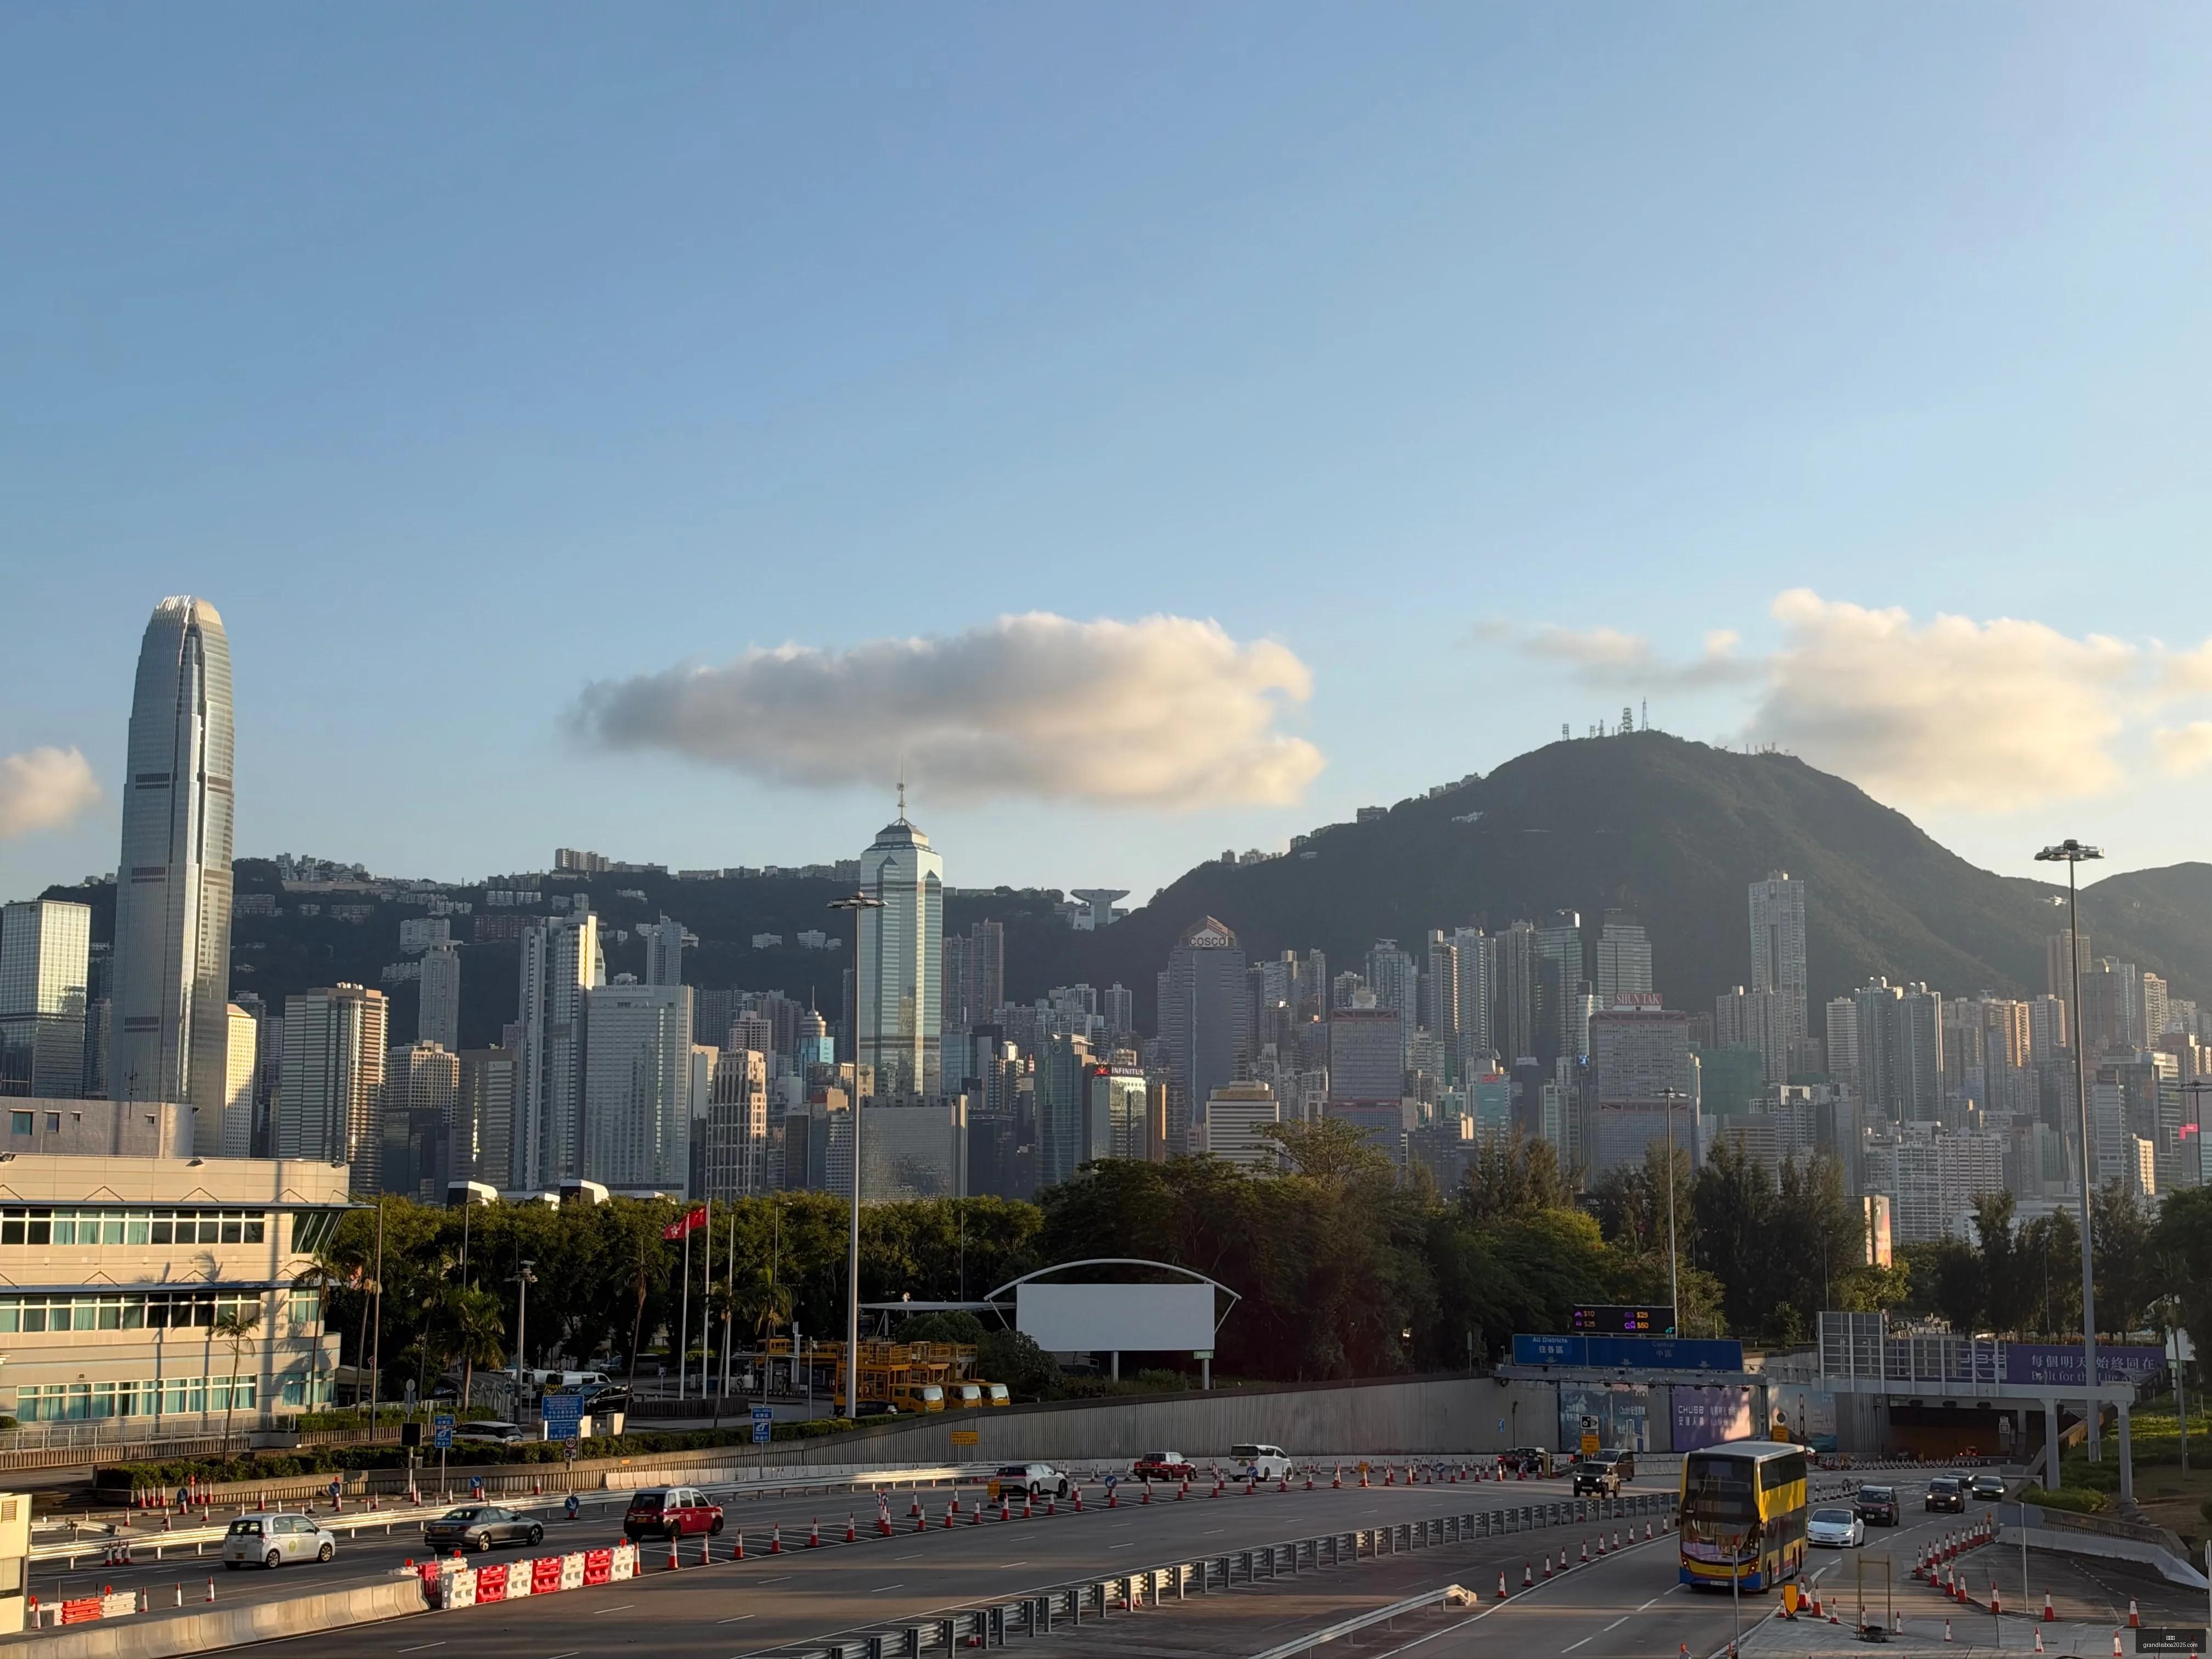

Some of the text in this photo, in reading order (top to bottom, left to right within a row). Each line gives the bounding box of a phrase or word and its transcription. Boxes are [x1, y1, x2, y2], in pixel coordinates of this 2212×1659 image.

[1189, 937, 1226, 946] COSCO
[1616, 993, 1660, 1005] SHUN TAK
[1111, 1066, 1144, 1075] INFINITUS
[1539, 1345, 1564, 1354] 往各區
[2032, 1355, 2155, 1370] 每個明天 始終同在
[2059, 1370, 2074, 1381] for
[1678, 1406, 1704, 1414] CHUBB
